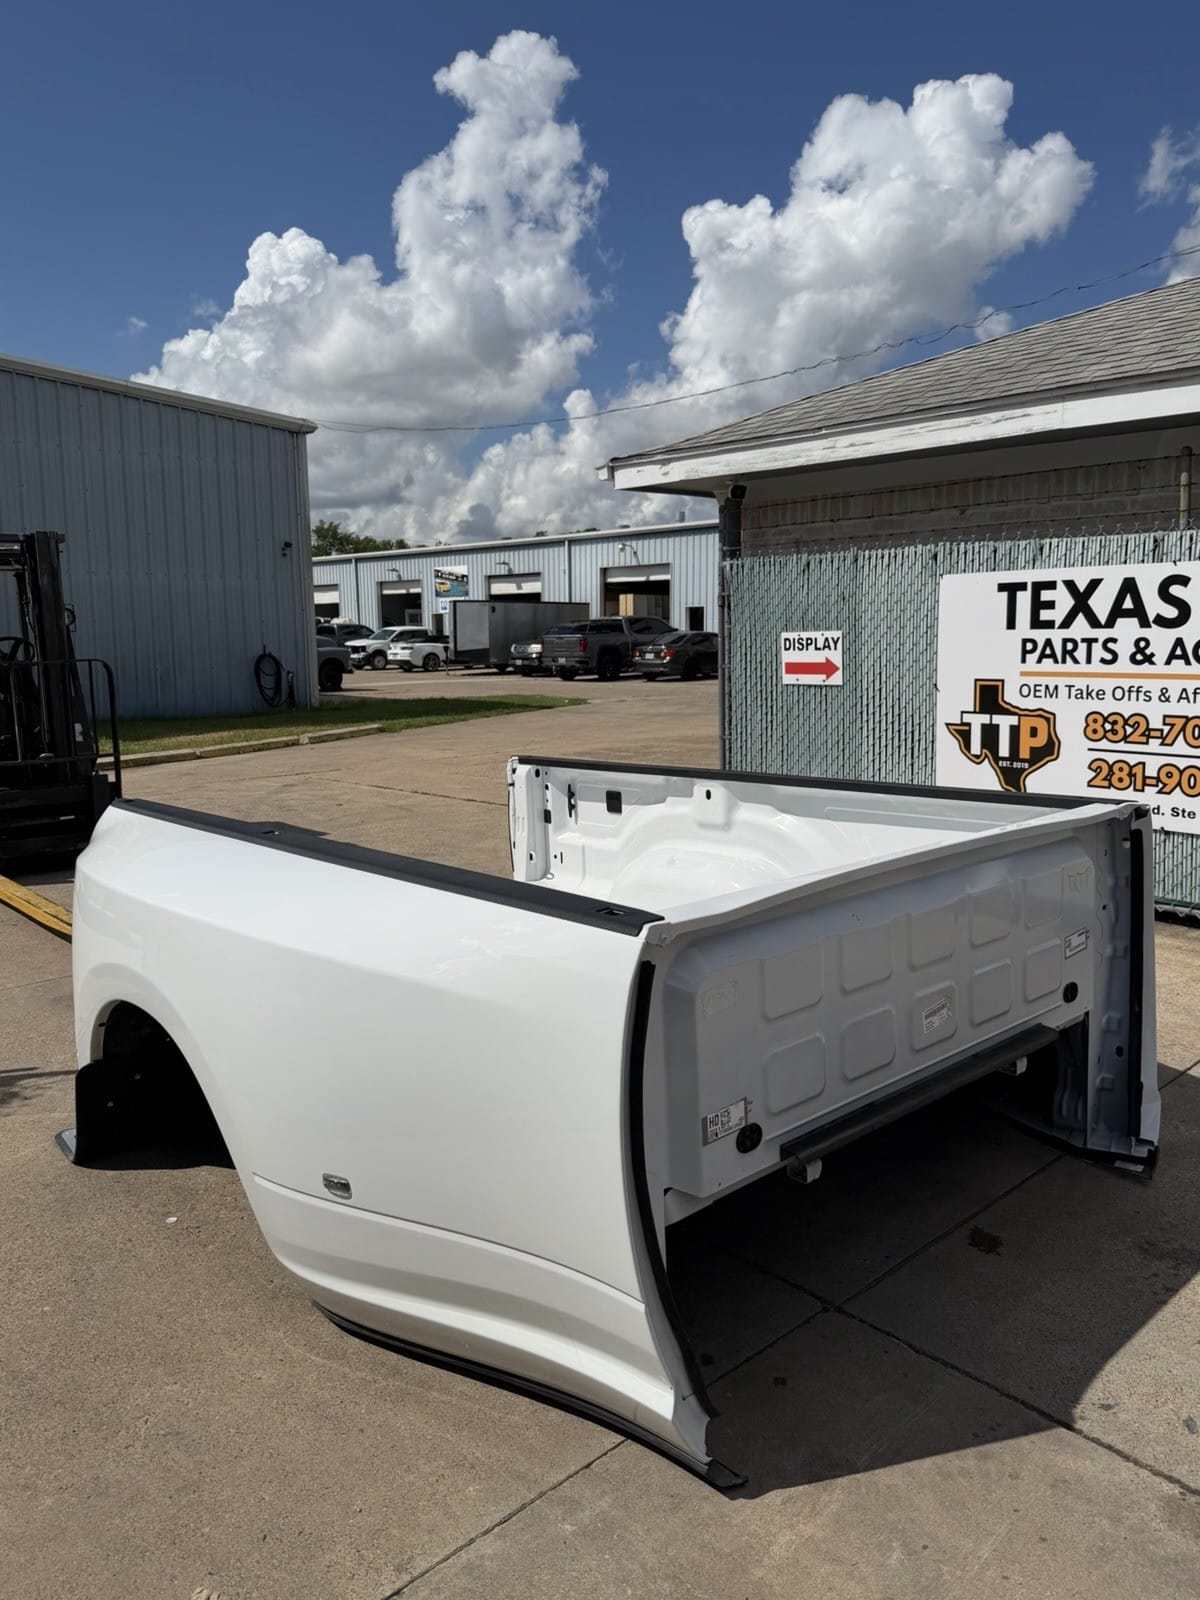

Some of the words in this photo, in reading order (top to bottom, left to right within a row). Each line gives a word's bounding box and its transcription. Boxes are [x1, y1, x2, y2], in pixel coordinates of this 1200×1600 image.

[997, 574, 1192, 630] TEXAS
[784, 637, 840, 651] DISPLAY
[1020, 637, 1119, 665] PARTS
[1129, 637, 1157, 666] &
[1019, 684, 1059, 700] OEM
[1065, 685, 1106, 701] Take
[1112, 685, 1152, 702] Offs
[1158, 687, 1171, 703] &
[961, 711, 1049, 760] TTP
[998, 760, 1012, 768] EST.
[1087, 758, 1200, 798] 281-90
[1171, 806, 1197, 820] Ste
